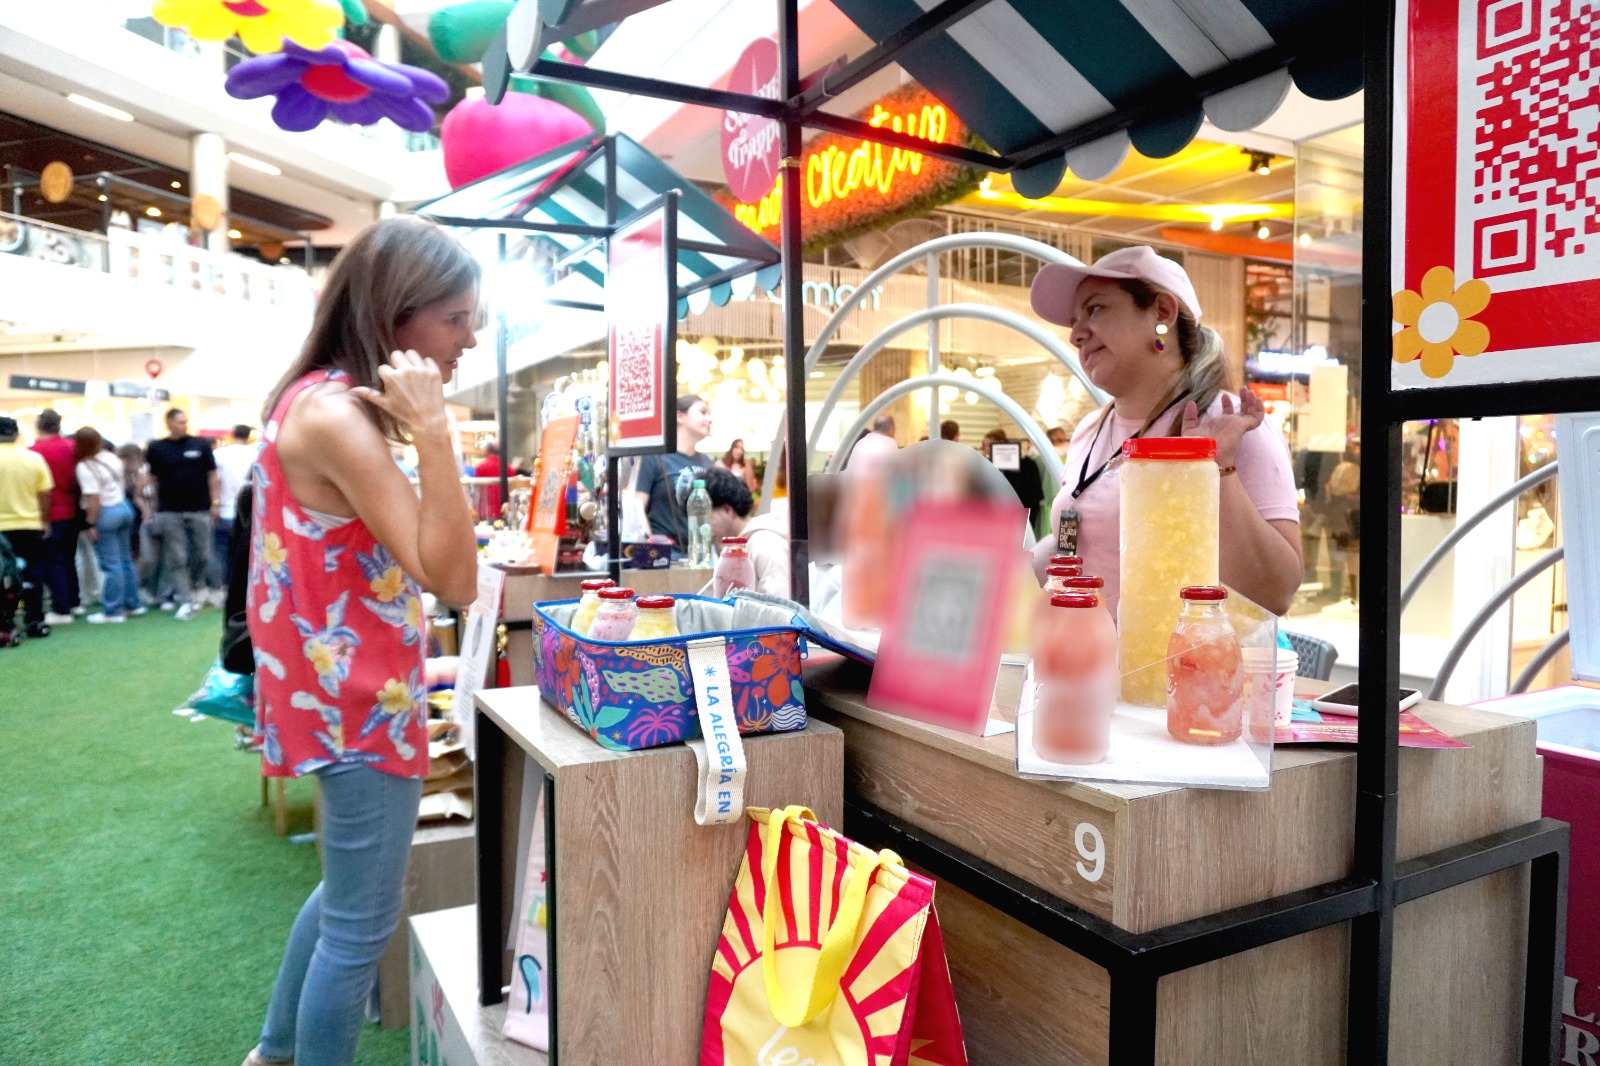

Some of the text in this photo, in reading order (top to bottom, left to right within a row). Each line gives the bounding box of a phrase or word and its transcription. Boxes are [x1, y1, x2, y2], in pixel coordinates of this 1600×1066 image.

[706, 686, 719, 707] LA
[709, 712, 737, 784] ALEGRÍA
[718, 791, 730, 813] EN
[1074, 822, 1105, 882] 9
